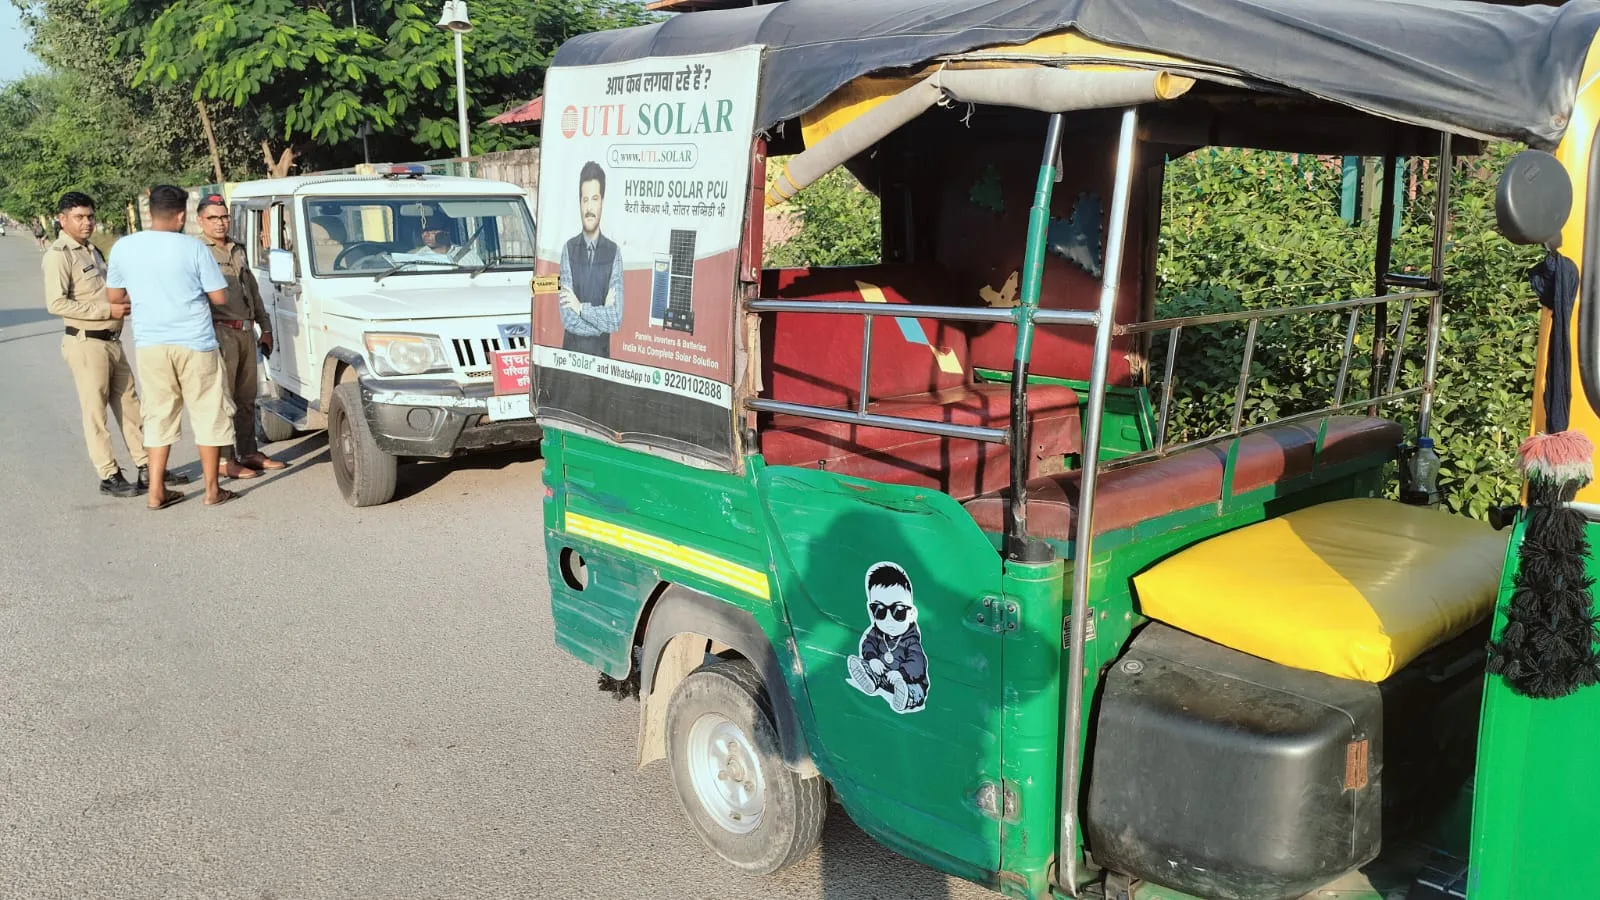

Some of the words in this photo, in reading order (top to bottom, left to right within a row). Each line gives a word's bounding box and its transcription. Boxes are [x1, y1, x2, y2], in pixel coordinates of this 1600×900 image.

[605, 76, 625, 95] आप
[626, 73, 642, 93] कब
[643, 71, 674, 92] लगवा
[675, 64, 692, 91] रहे
[582, 104, 631, 137] UTL
[637, 99, 733, 136] SOLAR
[620, 150, 692, 162] www.UTL.SOLAR
[625, 179, 664, 198] HYBRID
[667, 180, 704, 199] SOLAR
[706, 181, 728, 200] PCU
[622, 342, 637, 353] India
[637, 344, 646, 354] Ka
[646, 345, 674, 360] Complete
[674, 351, 692, 363] Solar
[692, 355, 719, 369] Solution
[553, 352, 567, 368] Type
[597, 364, 609, 375] and
[610, 364, 643, 384] WhatsApp
[644, 371, 651, 382] to
[664, 371, 722, 400] 9220102888
